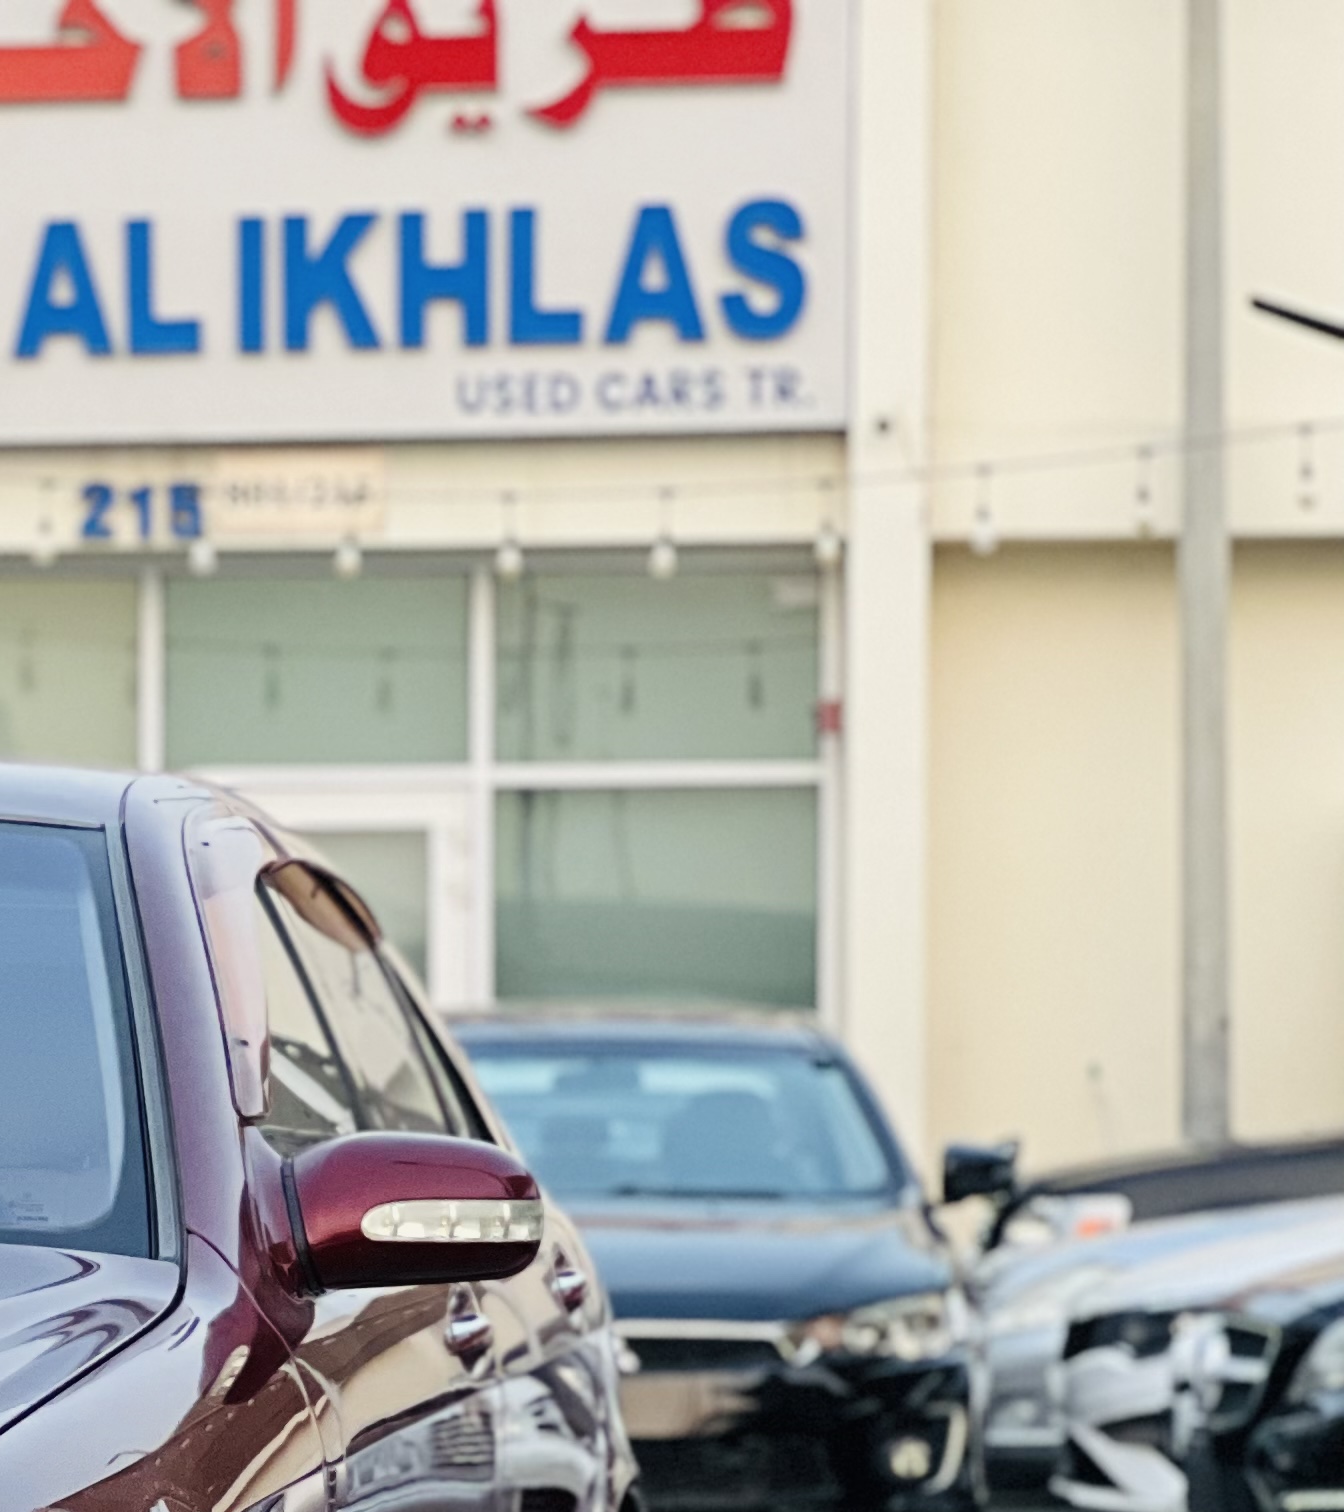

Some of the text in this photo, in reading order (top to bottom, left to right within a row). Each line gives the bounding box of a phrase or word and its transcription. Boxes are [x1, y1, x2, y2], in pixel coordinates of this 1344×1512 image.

[14, 220, 203, 359] AL
[236, 196, 809, 354] IKHLAS
[455, 371, 582, 416] USED
[594, 369, 726, 412] CARS
